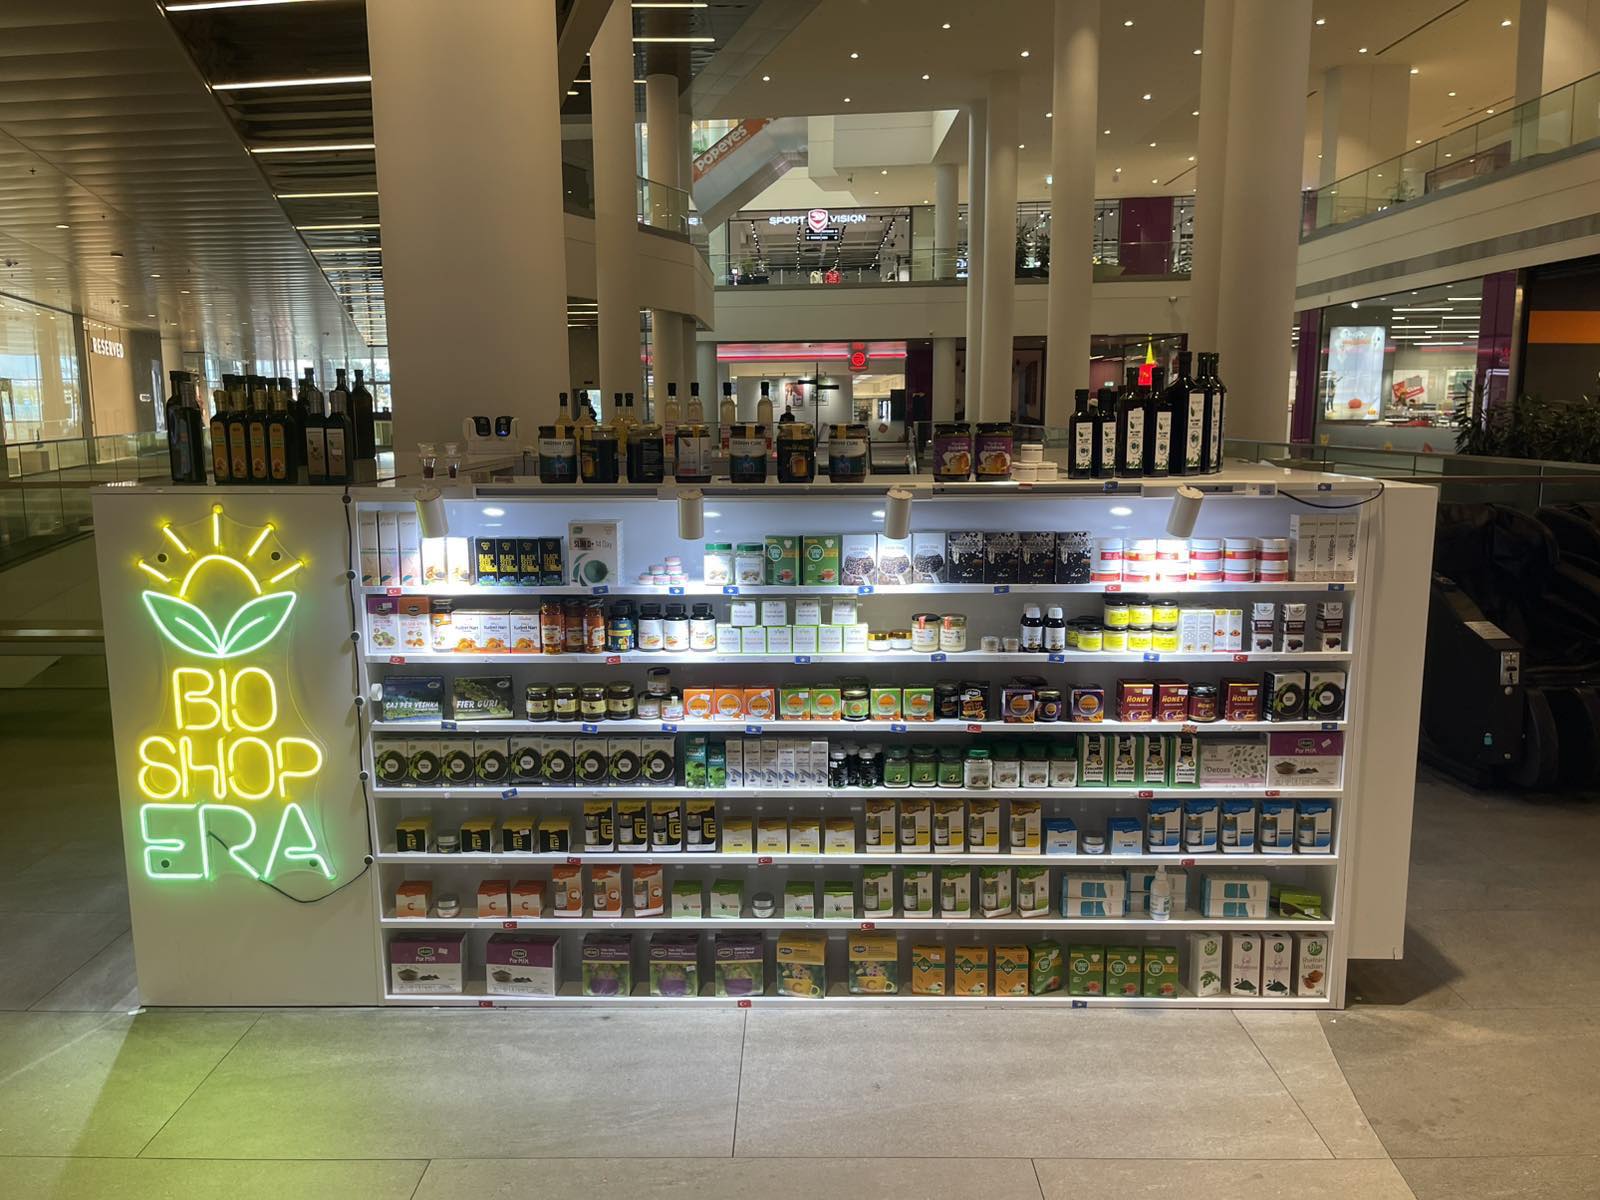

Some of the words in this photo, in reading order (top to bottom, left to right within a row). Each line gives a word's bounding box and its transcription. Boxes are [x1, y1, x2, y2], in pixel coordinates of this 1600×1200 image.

[769, 215, 806, 225] SPORT
[829, 214, 866, 223] VISION
[93, 337, 124, 358] RESERVED
[173, 666, 277, 732] BIO
[456, 700, 475, 708] FIER
[138, 736, 322, 800] SHOP
[140, 803, 336, 879] ERA
[408, 902, 414, 911] C
[489, 902, 496, 910] C
[522, 901, 529, 910] C
